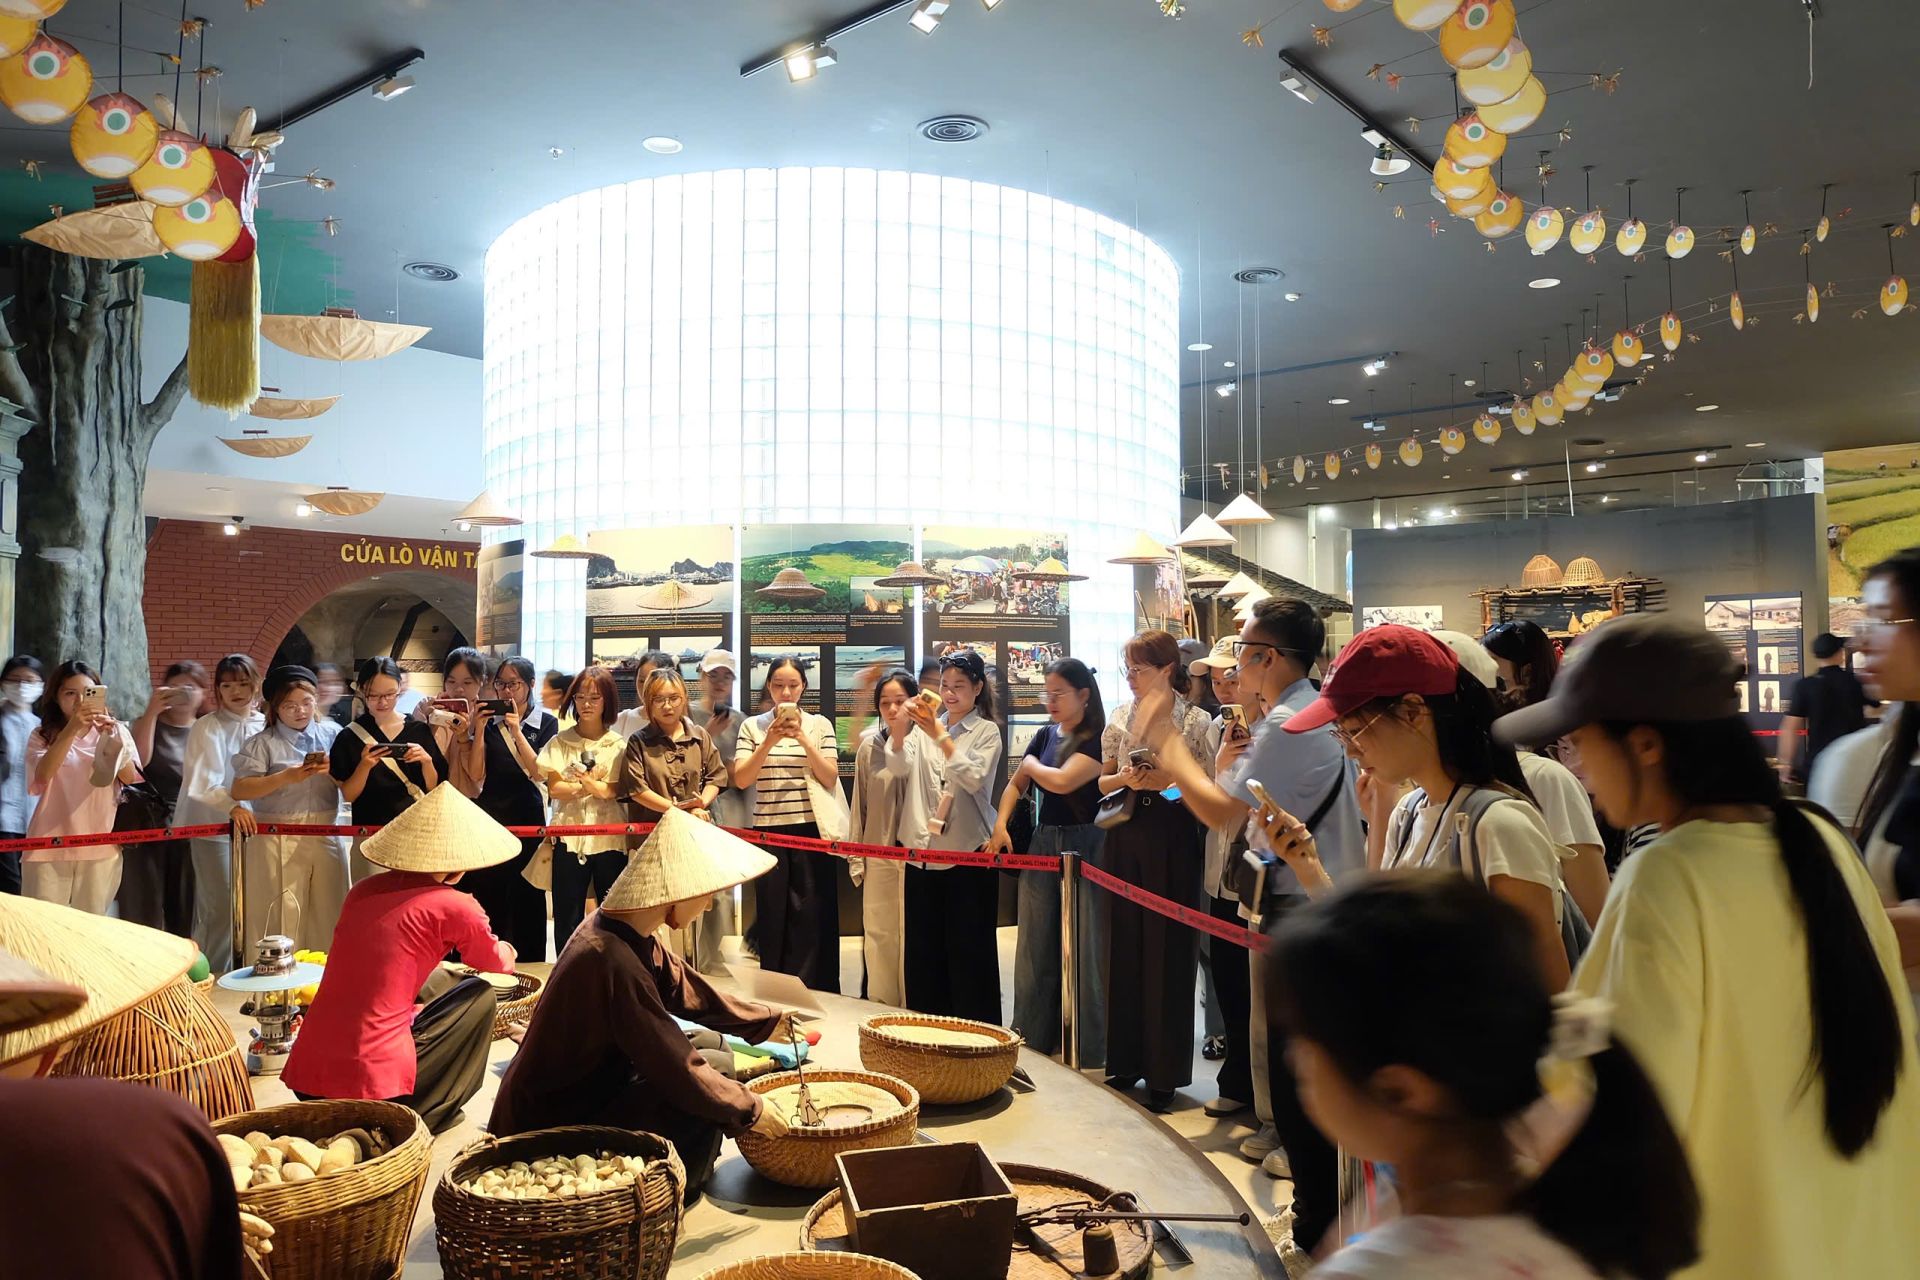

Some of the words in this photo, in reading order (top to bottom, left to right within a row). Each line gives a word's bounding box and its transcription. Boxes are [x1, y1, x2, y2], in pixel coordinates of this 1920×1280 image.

[340, 537, 385, 564] CỬA
[389, 542, 413, 565] LÒ
[418, 545, 458, 570] VẬN
